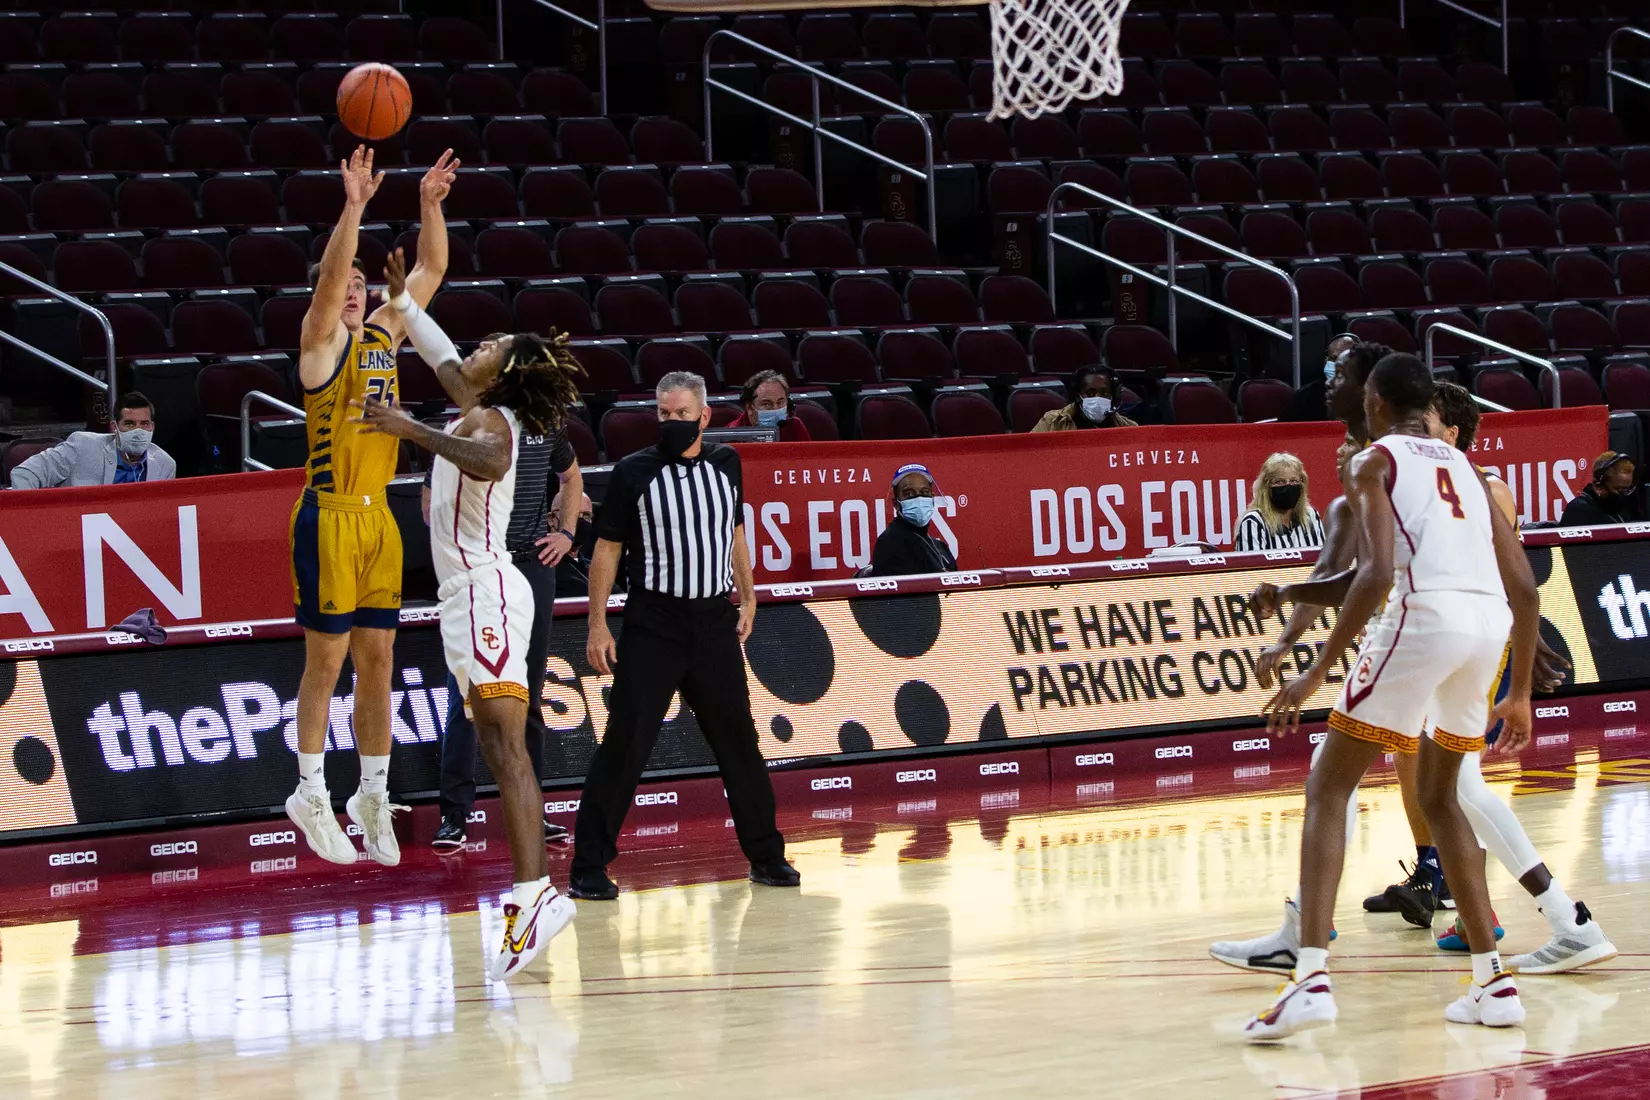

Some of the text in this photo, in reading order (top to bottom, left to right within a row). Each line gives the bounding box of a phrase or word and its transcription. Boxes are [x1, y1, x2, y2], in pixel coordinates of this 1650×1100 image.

[1109, 450, 1200, 468] CERVEZA
[774, 468, 872, 485] CERVEZA
[1435, 466, 1465, 519] 4
[1030, 483, 1126, 557] DOS
[1187, 556, 1226, 566] GEICO
[1264, 551, 1303, 561] GEICO
[1030, 567, 1070, 577] GEICO
[1109, 561, 1149, 571] GEICO
[856, 580, 898, 592] GEICO
[940, 574, 981, 586] GEICO
[771, 585, 813, 597] GEICO
[203, 624, 253, 638] GEICO
[1003, 608, 1069, 655] WE
[1074, 600, 1182, 649] HAVE
[4, 640, 54, 652] GEICO
[1007, 654, 1185, 712] PARKING
[1536, 706, 1569, 718] GEICO
[1603, 701, 1636, 713] GEICO
[1233, 738, 1270, 751] GEICO
[1155, 746, 1193, 758] GEICO
[1075, 752, 1114, 766] GEICO
[980, 762, 1019, 775] GEICO
[896, 769, 936, 782] GEICO
[811, 776, 852, 790] GEICO
[635, 791, 678, 806] GEICO
[249, 830, 296, 846] GEICO
[150, 840, 198, 856] GEICO
[49, 851, 97, 866] GEICO
